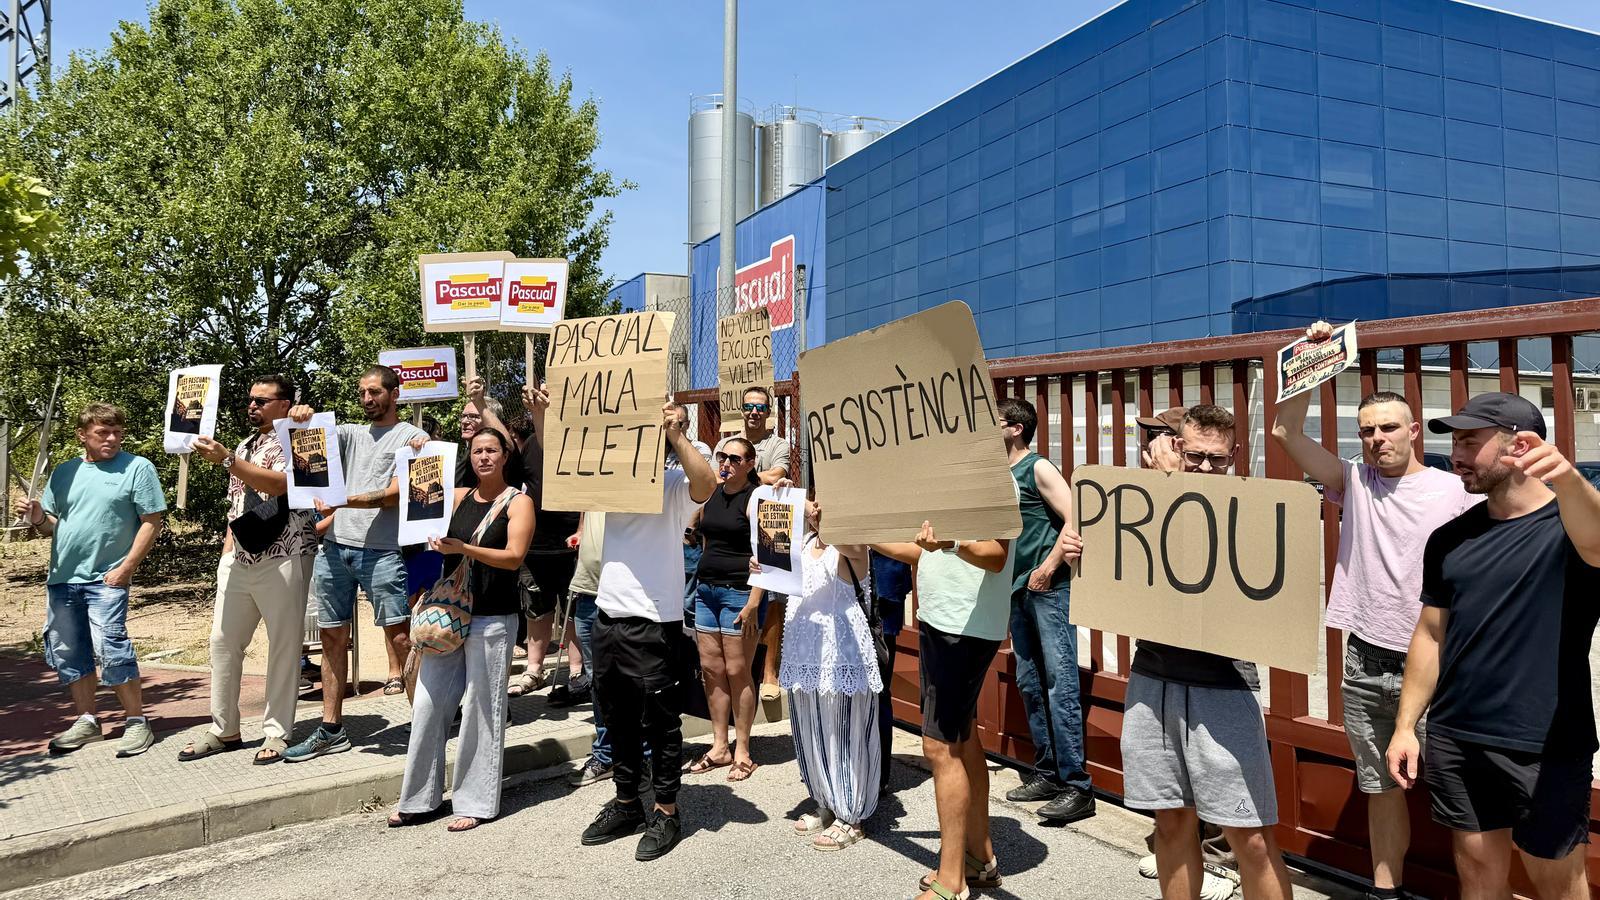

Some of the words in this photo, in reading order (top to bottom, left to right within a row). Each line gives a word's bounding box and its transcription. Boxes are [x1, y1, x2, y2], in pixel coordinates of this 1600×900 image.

[440, 281, 500, 298] Pascual
[511, 284, 554, 300] Pascual
[720, 320, 735, 338] NO
[736, 310, 770, 333] VOLEM
[549, 314, 663, 366] PASCUAL
[721, 334, 772, 361] EXCUSES,
[730, 360, 764, 385] VOLEM
[560, 368, 638, 422] MALA
[808, 364, 996, 464] RESISTÈNCIA
[556, 424, 663, 484] LLET!
[422, 463, 439, 474] ESTIMA
[763, 512, 769, 520] NO
[770, 512, 789, 520] ESTIMA
[770, 504, 791, 512] PASCUAL
[1076, 479, 1286, 600] PROU
